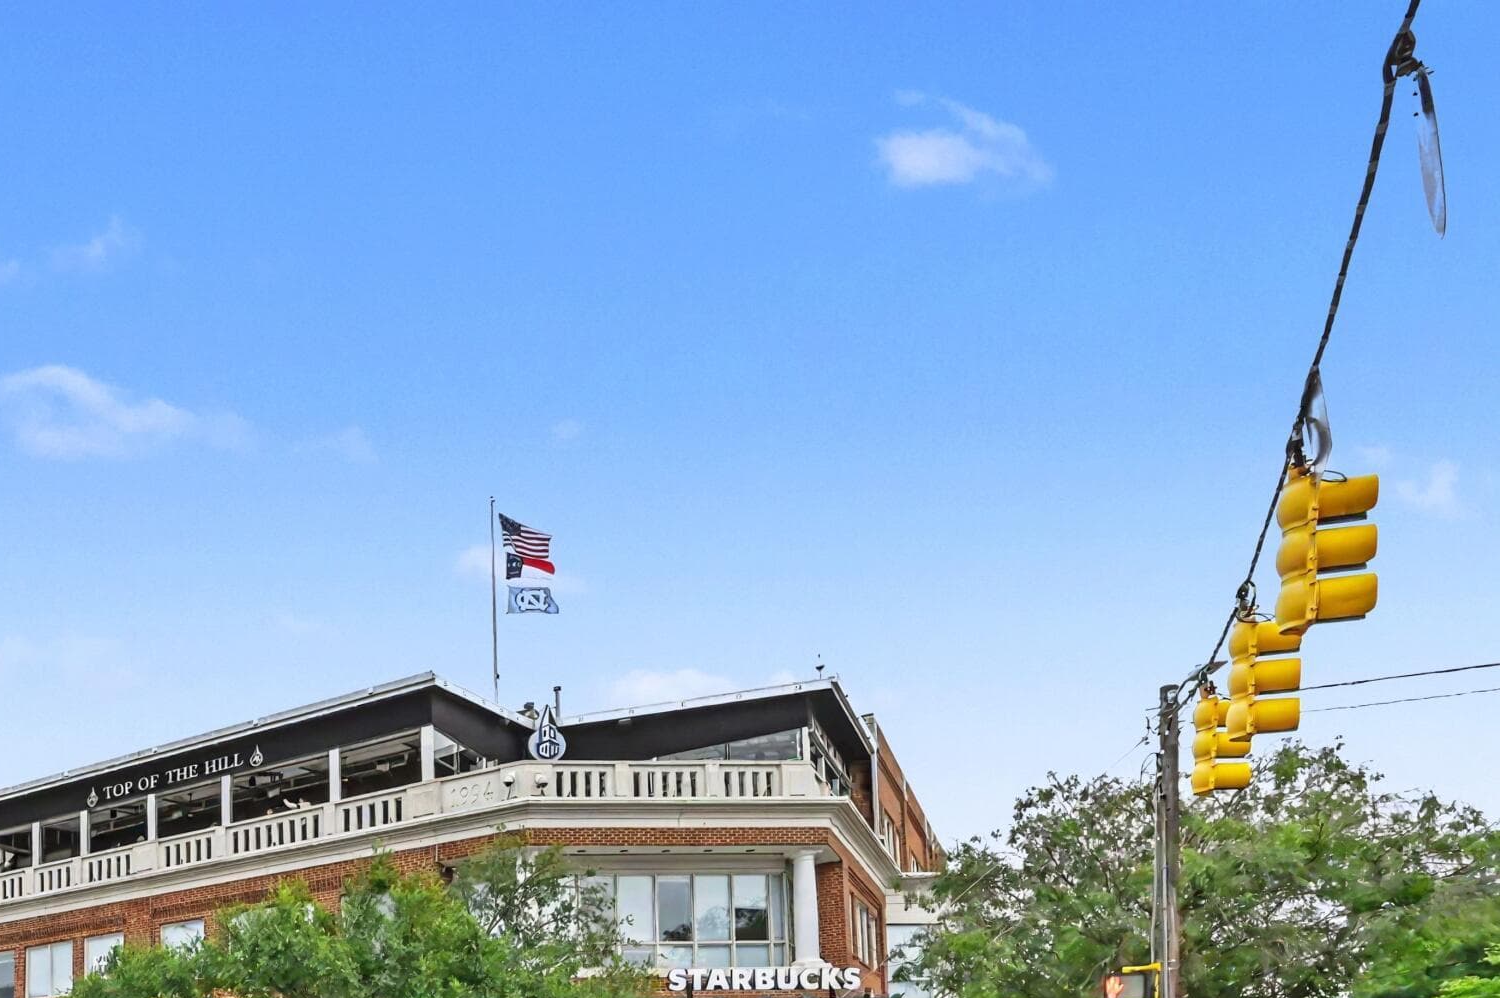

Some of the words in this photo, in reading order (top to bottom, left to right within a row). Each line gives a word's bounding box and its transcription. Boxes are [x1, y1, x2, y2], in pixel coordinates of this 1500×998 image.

[103, 781, 133, 799] TOP
[138, 774, 159, 791] OF
[165, 764, 198, 784] THE
[204, 753, 244, 775] HILL
[668, 968, 861, 991] STARBUCKS
